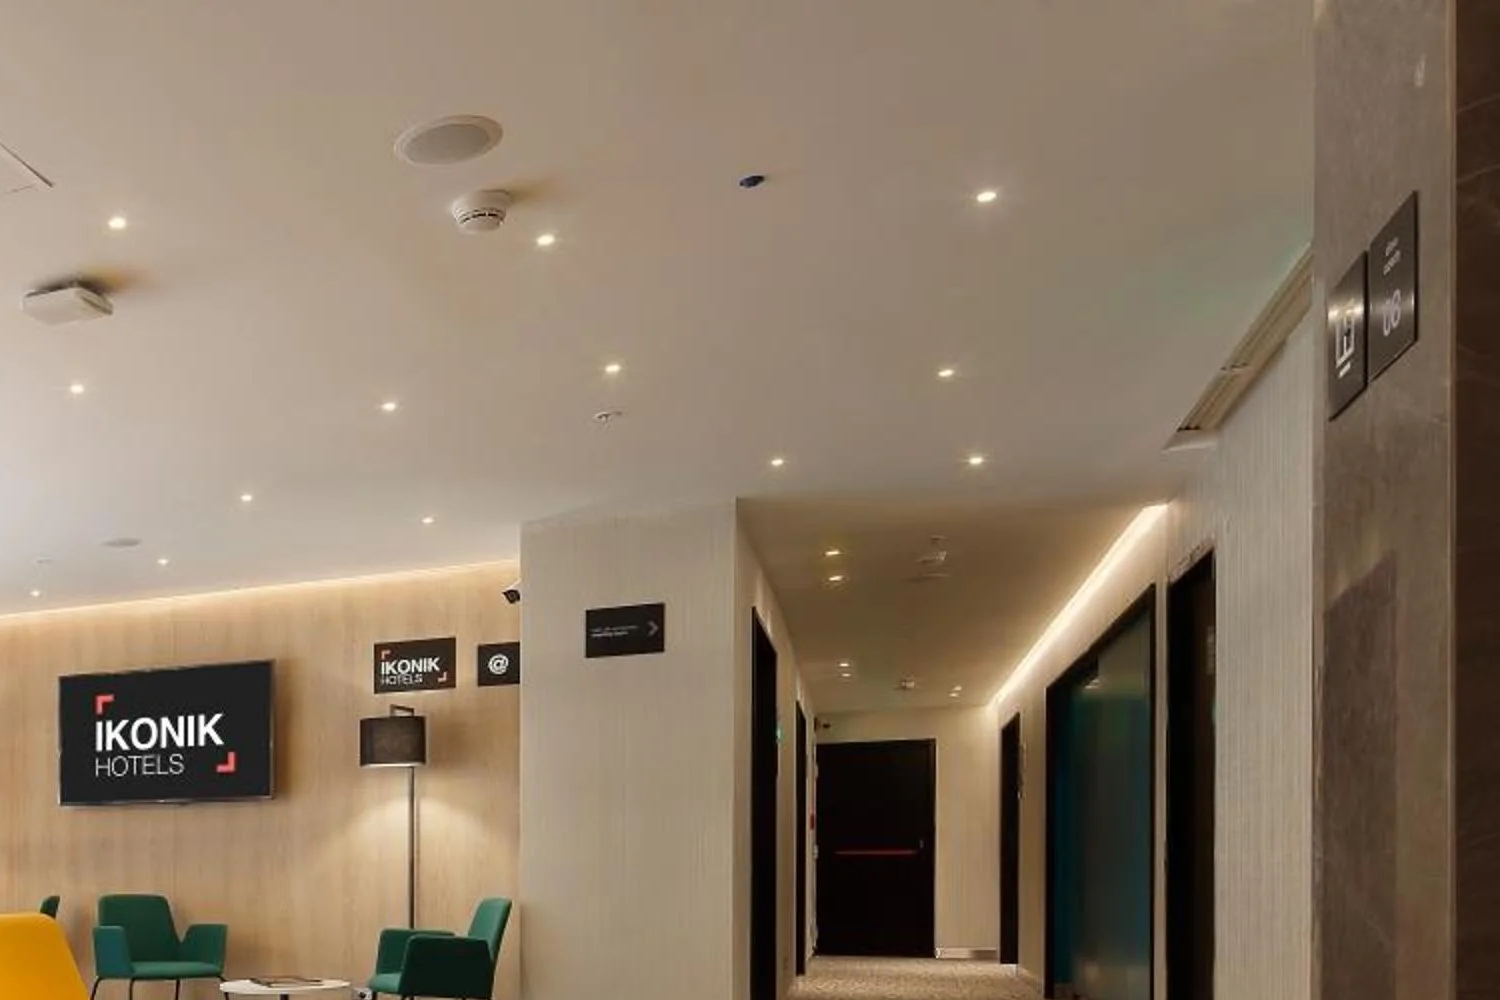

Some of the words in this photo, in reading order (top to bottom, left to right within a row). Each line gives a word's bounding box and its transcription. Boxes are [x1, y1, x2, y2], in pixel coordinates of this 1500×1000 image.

[381, 657, 440, 675] IKONIK
[381, 673, 423, 685] HOTELS
[95, 713, 224, 752] IKONIK
[95, 753, 185, 777] HOTELS
